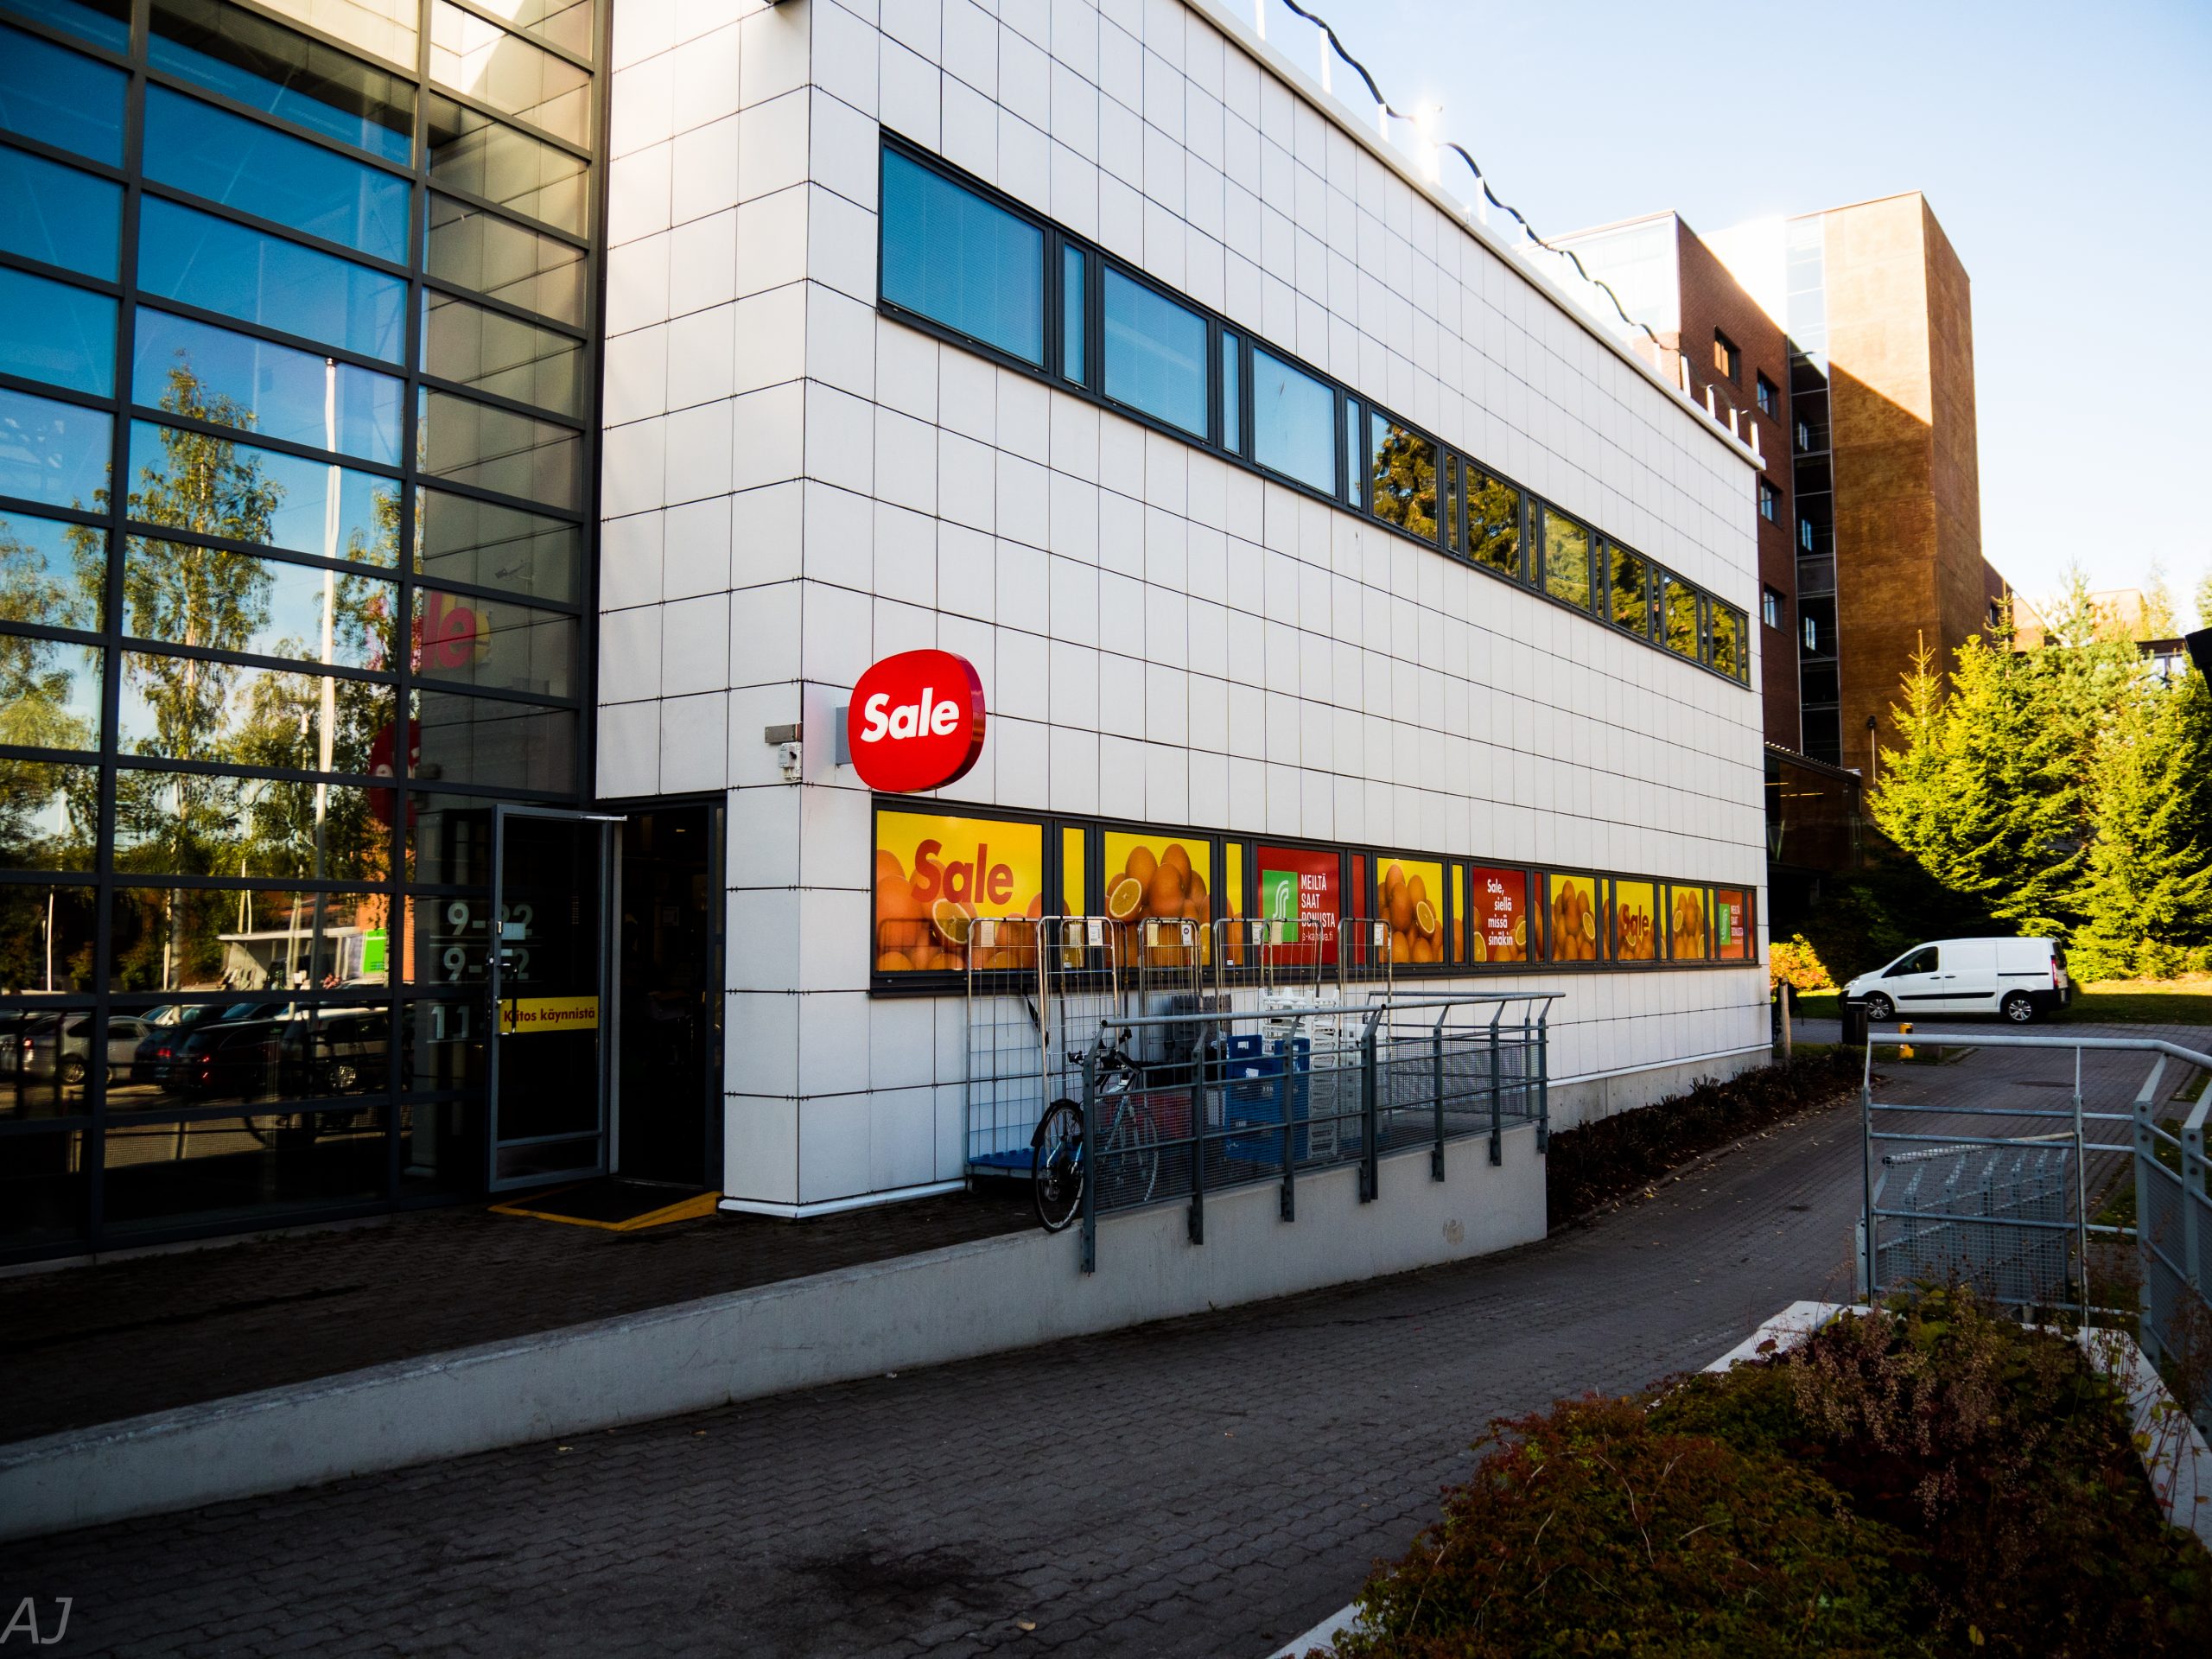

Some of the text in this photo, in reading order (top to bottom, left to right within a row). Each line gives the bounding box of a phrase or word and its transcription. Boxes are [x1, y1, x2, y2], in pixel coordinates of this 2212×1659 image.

[861, 687, 959, 743] Sale
[912, 839, 1014, 906] Sale
[1301, 874, 1327, 891] MEILTÄ
[1487, 878, 1504, 895] Sale,
[1301, 893, 1320, 909] SAAT
[1494, 896, 1512, 912] siellä
[1301, 911, 1336, 928] BONUSTA
[1488, 913, 1508, 929] missä
[1622, 905, 1649, 938] Sale
[1488, 931, 1513, 946] sinäkin
[504, 1007, 595, 1024] Kitos käynnistä
